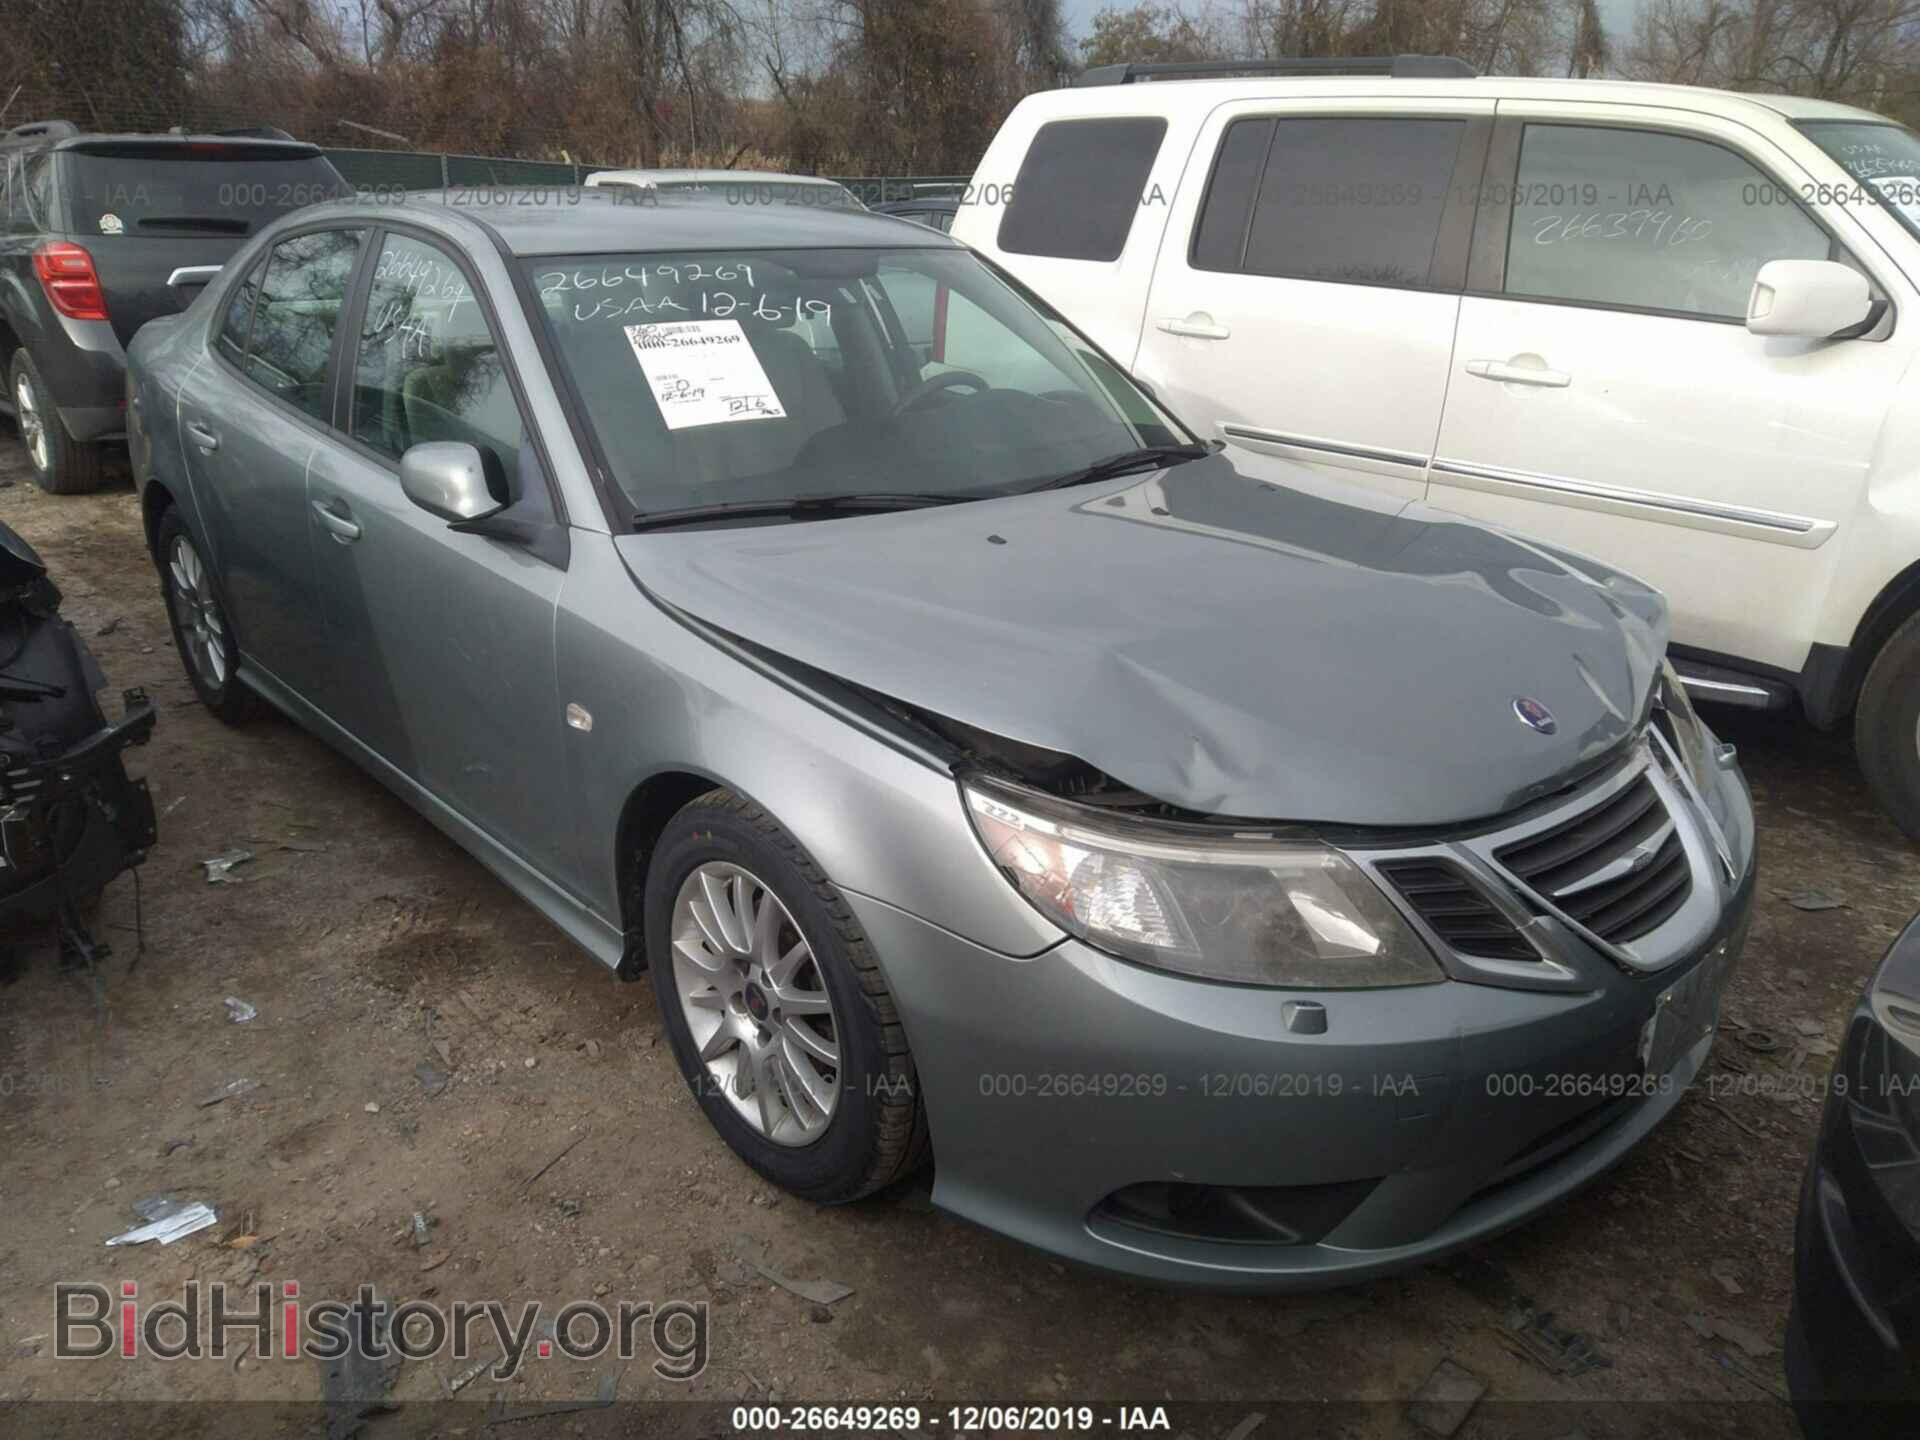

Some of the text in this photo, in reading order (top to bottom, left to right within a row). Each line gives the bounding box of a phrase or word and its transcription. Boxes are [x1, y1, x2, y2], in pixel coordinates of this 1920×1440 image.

[541, 263, 756, 297] 26649269
[575, 290, 832, 327] USAA 12-6-19
